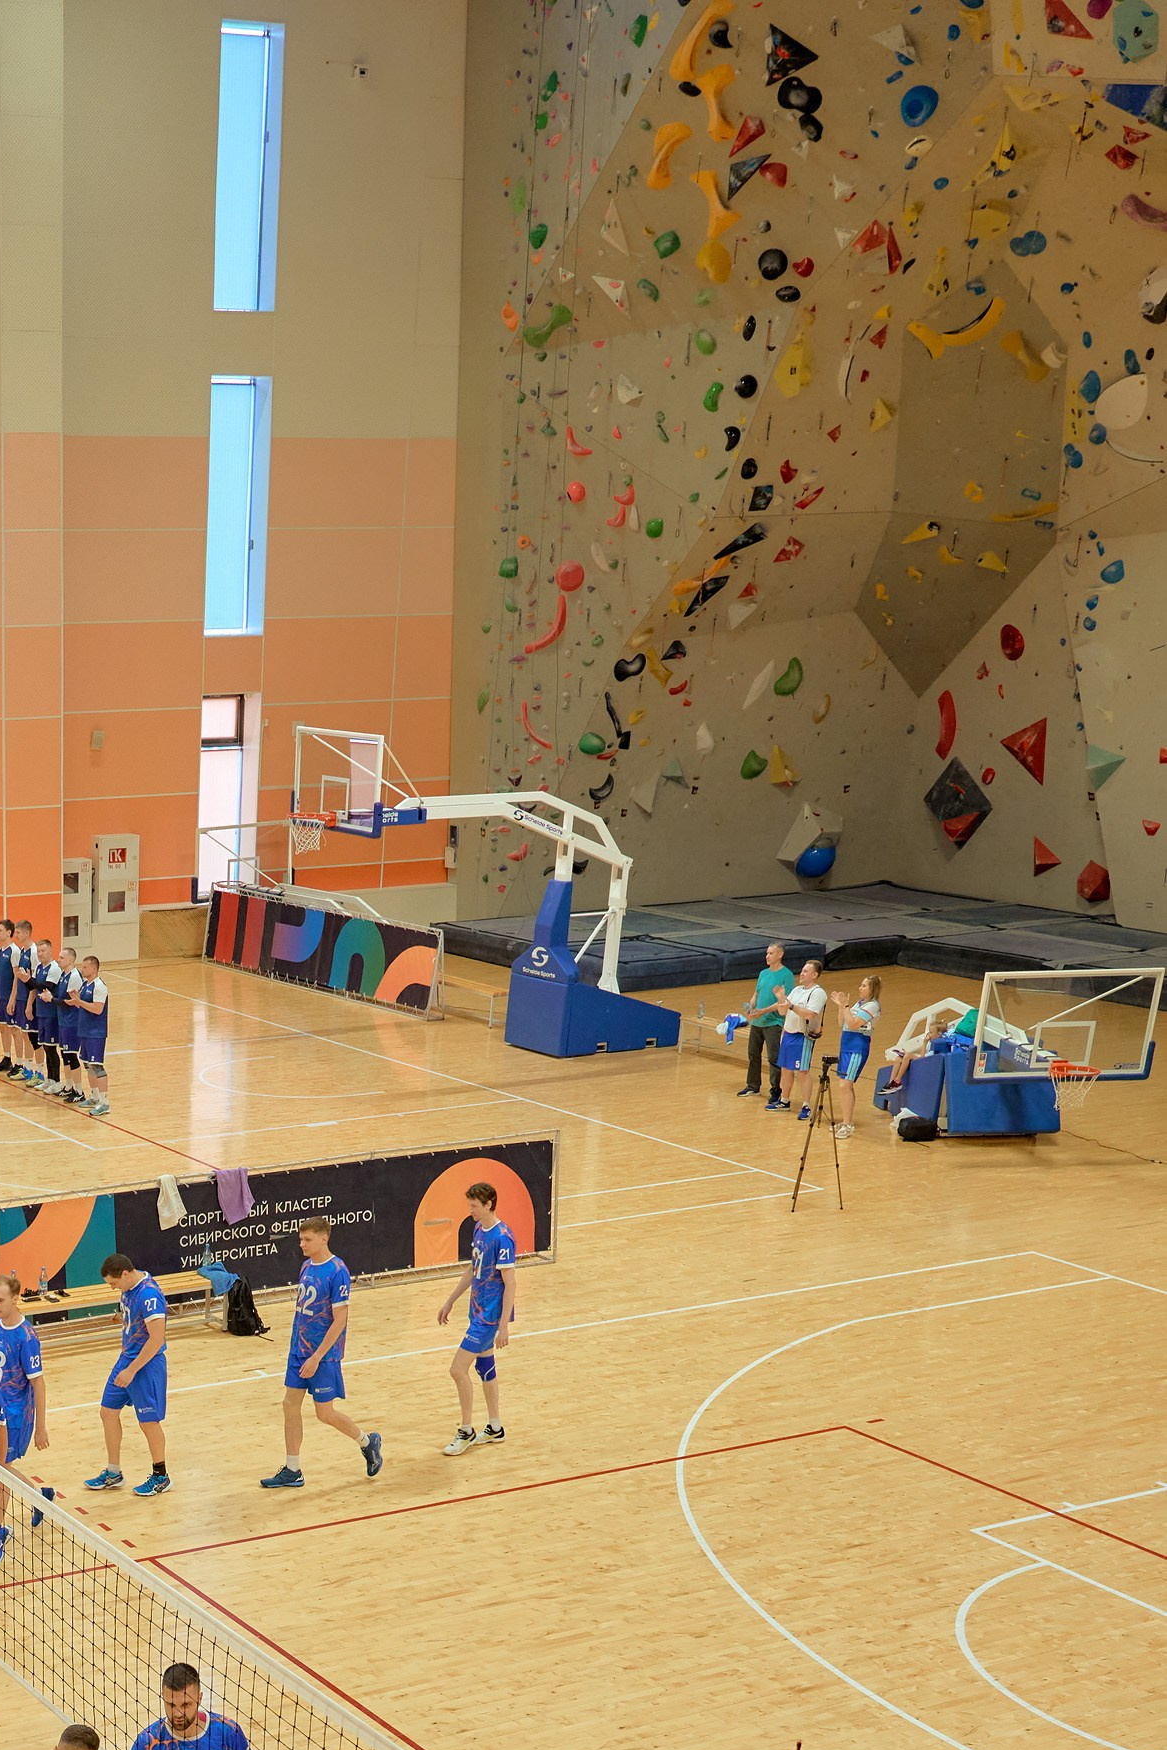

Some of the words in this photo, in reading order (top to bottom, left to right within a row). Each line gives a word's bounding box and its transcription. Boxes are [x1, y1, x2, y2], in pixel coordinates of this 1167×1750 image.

[545, 823, 563, 836] Sports
[795, 1060, 801, 1069] 5
[275, 1195, 332, 1214] КЛАСТЕР
[179, 1223, 266, 1248] СИБИРСКОГО
[499, 1248, 510, 1260] 21
[144, 1298, 157, 1312] 27
[29, 1355, 40, 1369] 23
